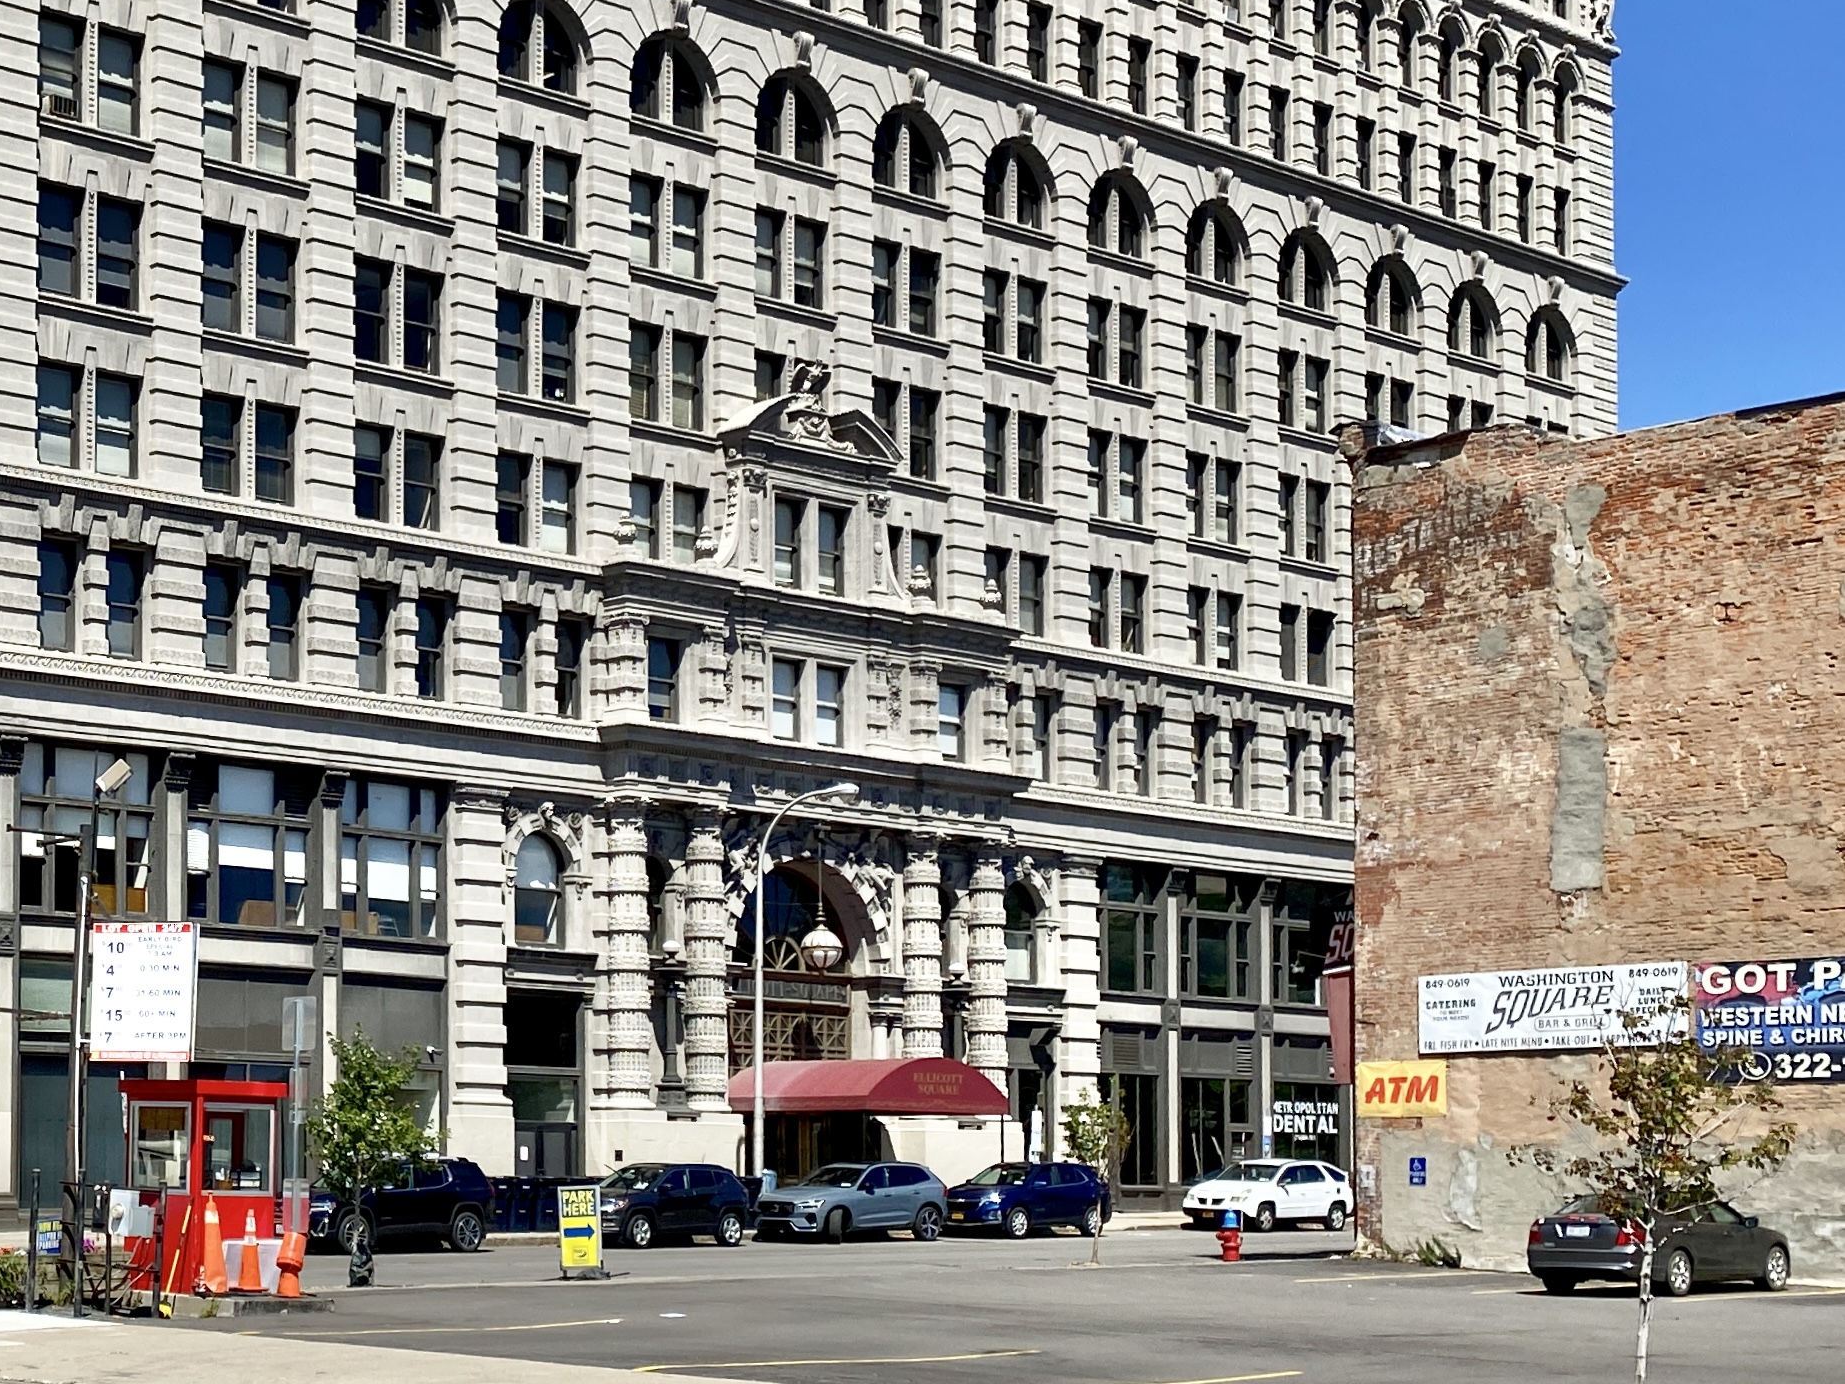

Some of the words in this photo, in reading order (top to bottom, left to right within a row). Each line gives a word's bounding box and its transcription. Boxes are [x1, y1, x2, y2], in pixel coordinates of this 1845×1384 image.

[1498, 970, 1614, 988] WASHINGTON
[1628, 966, 1679, 979] 849-0619
[1701, 962, 1796, 995] GOT
[1814, 959, 1845, 990] P
[1424, 977, 1471, 990] 849-0619
[1425, 998, 1476, 1011] CATERING
[1485, 984, 1615, 1035] SQUARE
[158, 1009, 176, 1017] MIN
[1701, 1005, 1813, 1027] WESTERN
[1538, 1018, 1560, 1029] BAR
[1563, 1017, 1571, 1027] &
[134, 1031, 165, 1040] AFTER
[1703, 1030, 1764, 1047] SPINE
[1769, 1030, 1784, 1045] &
[1791, 1028, 1845, 1044] CHIR
[1774, 1052, 1845, 1079] 322-
[1364, 1075, 1439, 1104] ATM
[1273, 1114, 1338, 1134] DENTAL
[562, 1191, 594, 1203] PARK
[563, 1203, 595, 1216] HERE
